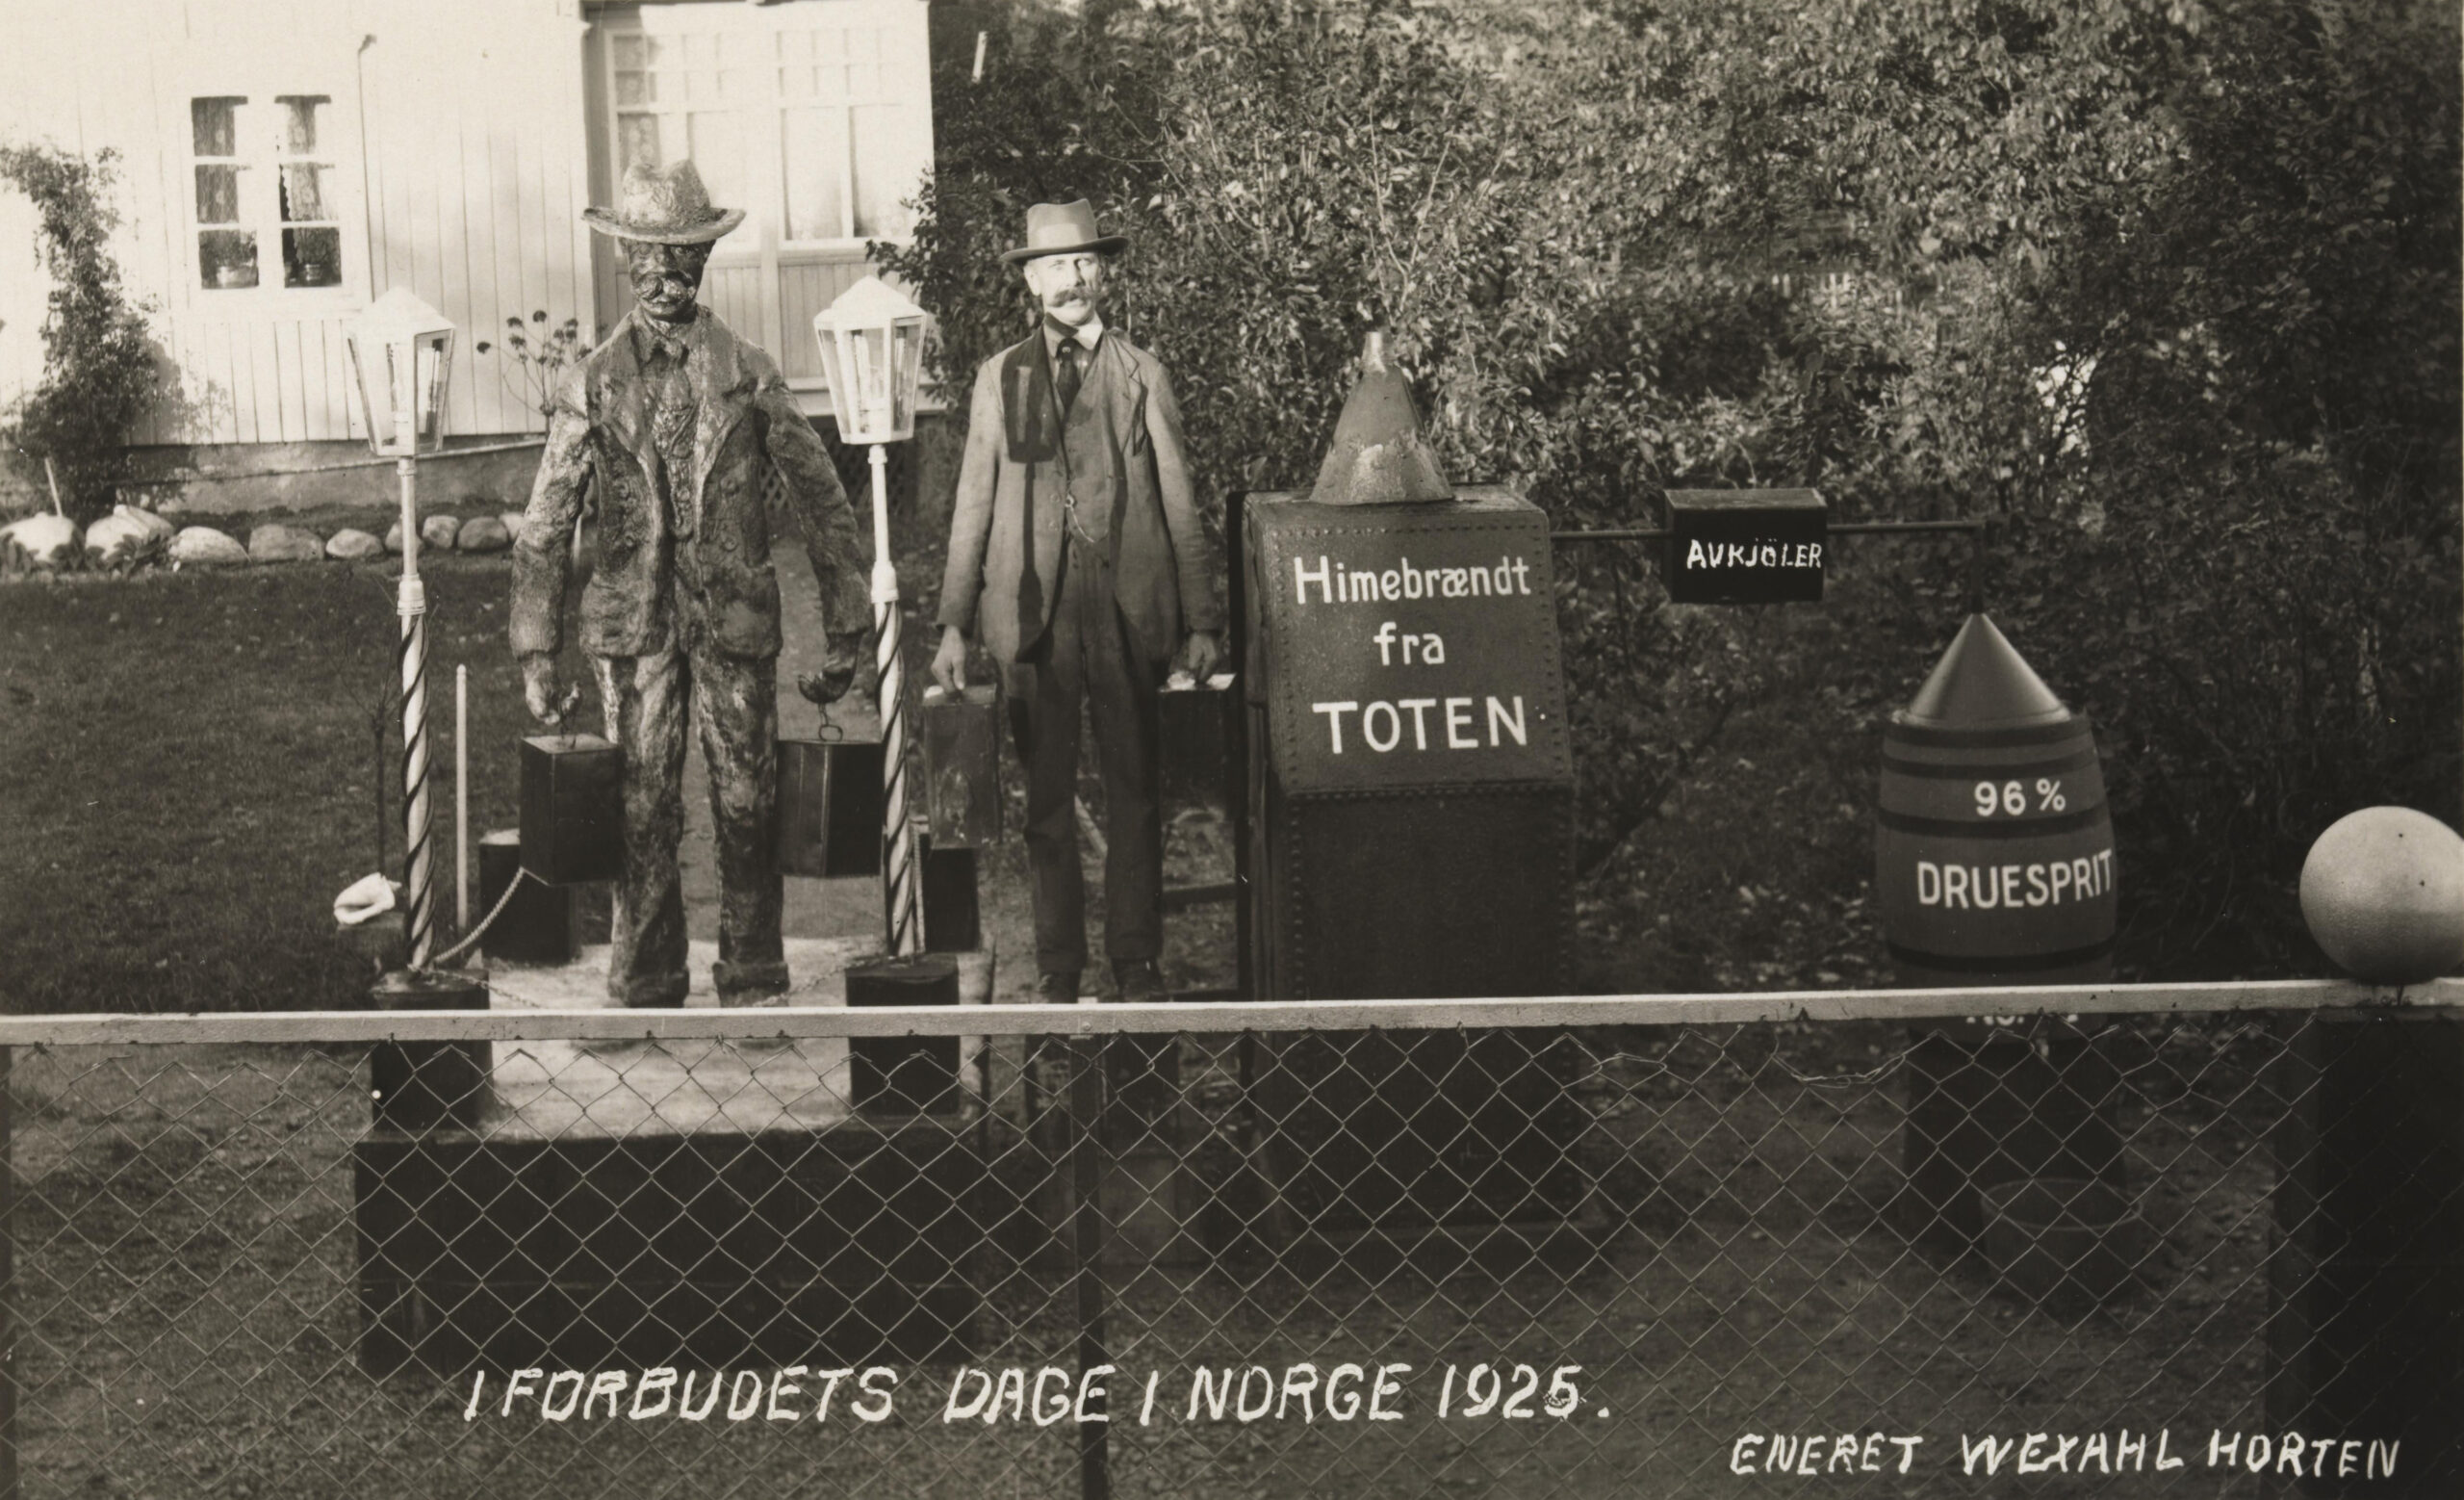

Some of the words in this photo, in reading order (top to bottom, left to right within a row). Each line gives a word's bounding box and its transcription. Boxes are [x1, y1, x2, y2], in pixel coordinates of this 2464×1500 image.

[1293, 555, 1531, 606] Himebrændt
[1373, 621, 1445, 666] fra
[1312, 696, 1527, 754] TOTEN
[1916, 848, 2113, 910] DRUESPRIT
